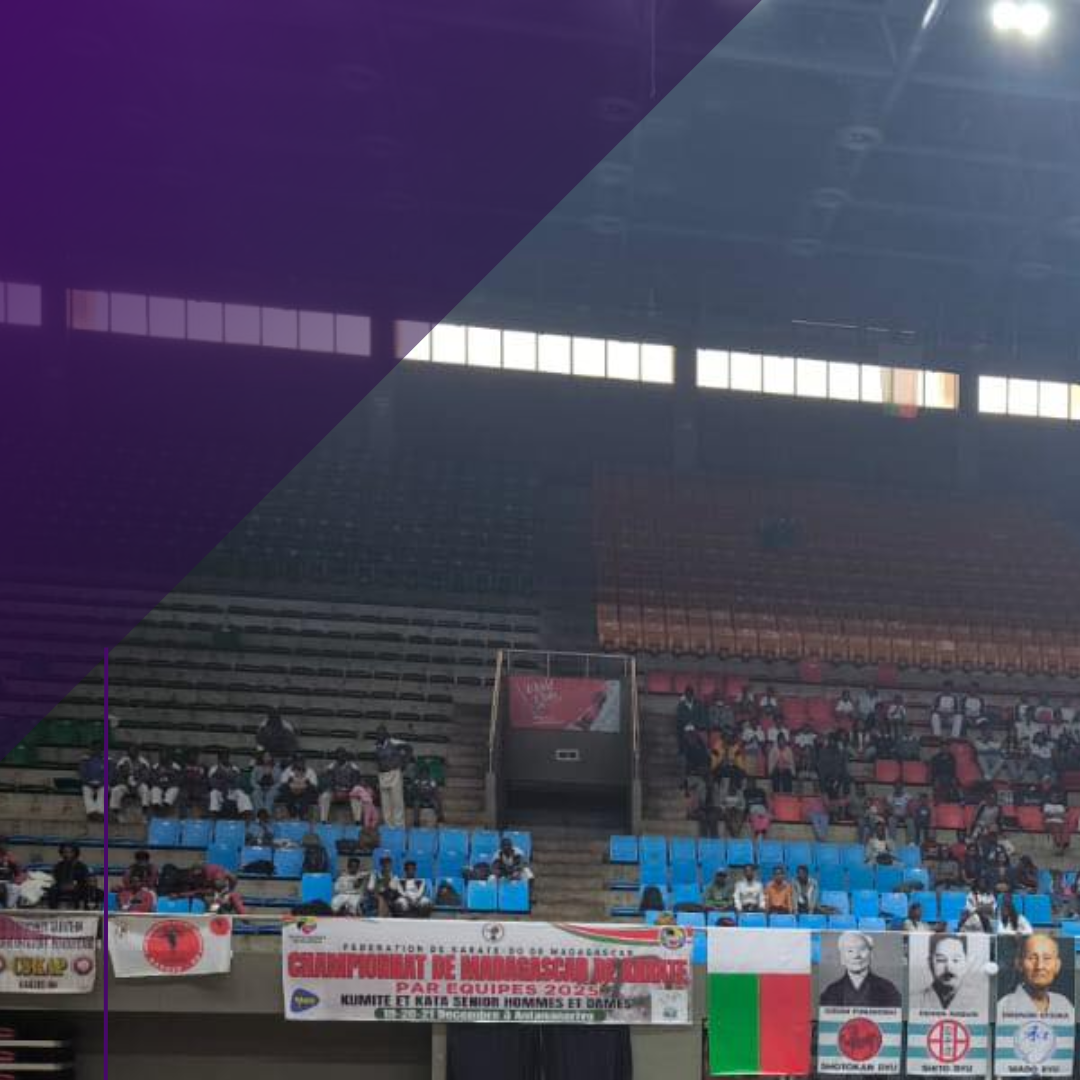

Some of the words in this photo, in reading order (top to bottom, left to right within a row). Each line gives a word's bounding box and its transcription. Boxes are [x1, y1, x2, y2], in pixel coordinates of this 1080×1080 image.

[431, 954, 456, 980] DE
[396, 982, 441, 994] PAR
[446, 982, 537, 996] EQUIPES
[545, 984, 599, 997] 2025
[341, 994, 391, 1006] KUMITE
[396, 995, 410, 1007] ET
[415, 995, 449, 1007] KATA
[453, 996, 500, 1008] SENIOR
[504, 997, 564, 1009] HOMMES
[568, 998, 581, 1009] ET
[586, 998, 632, 1010] DAMES
